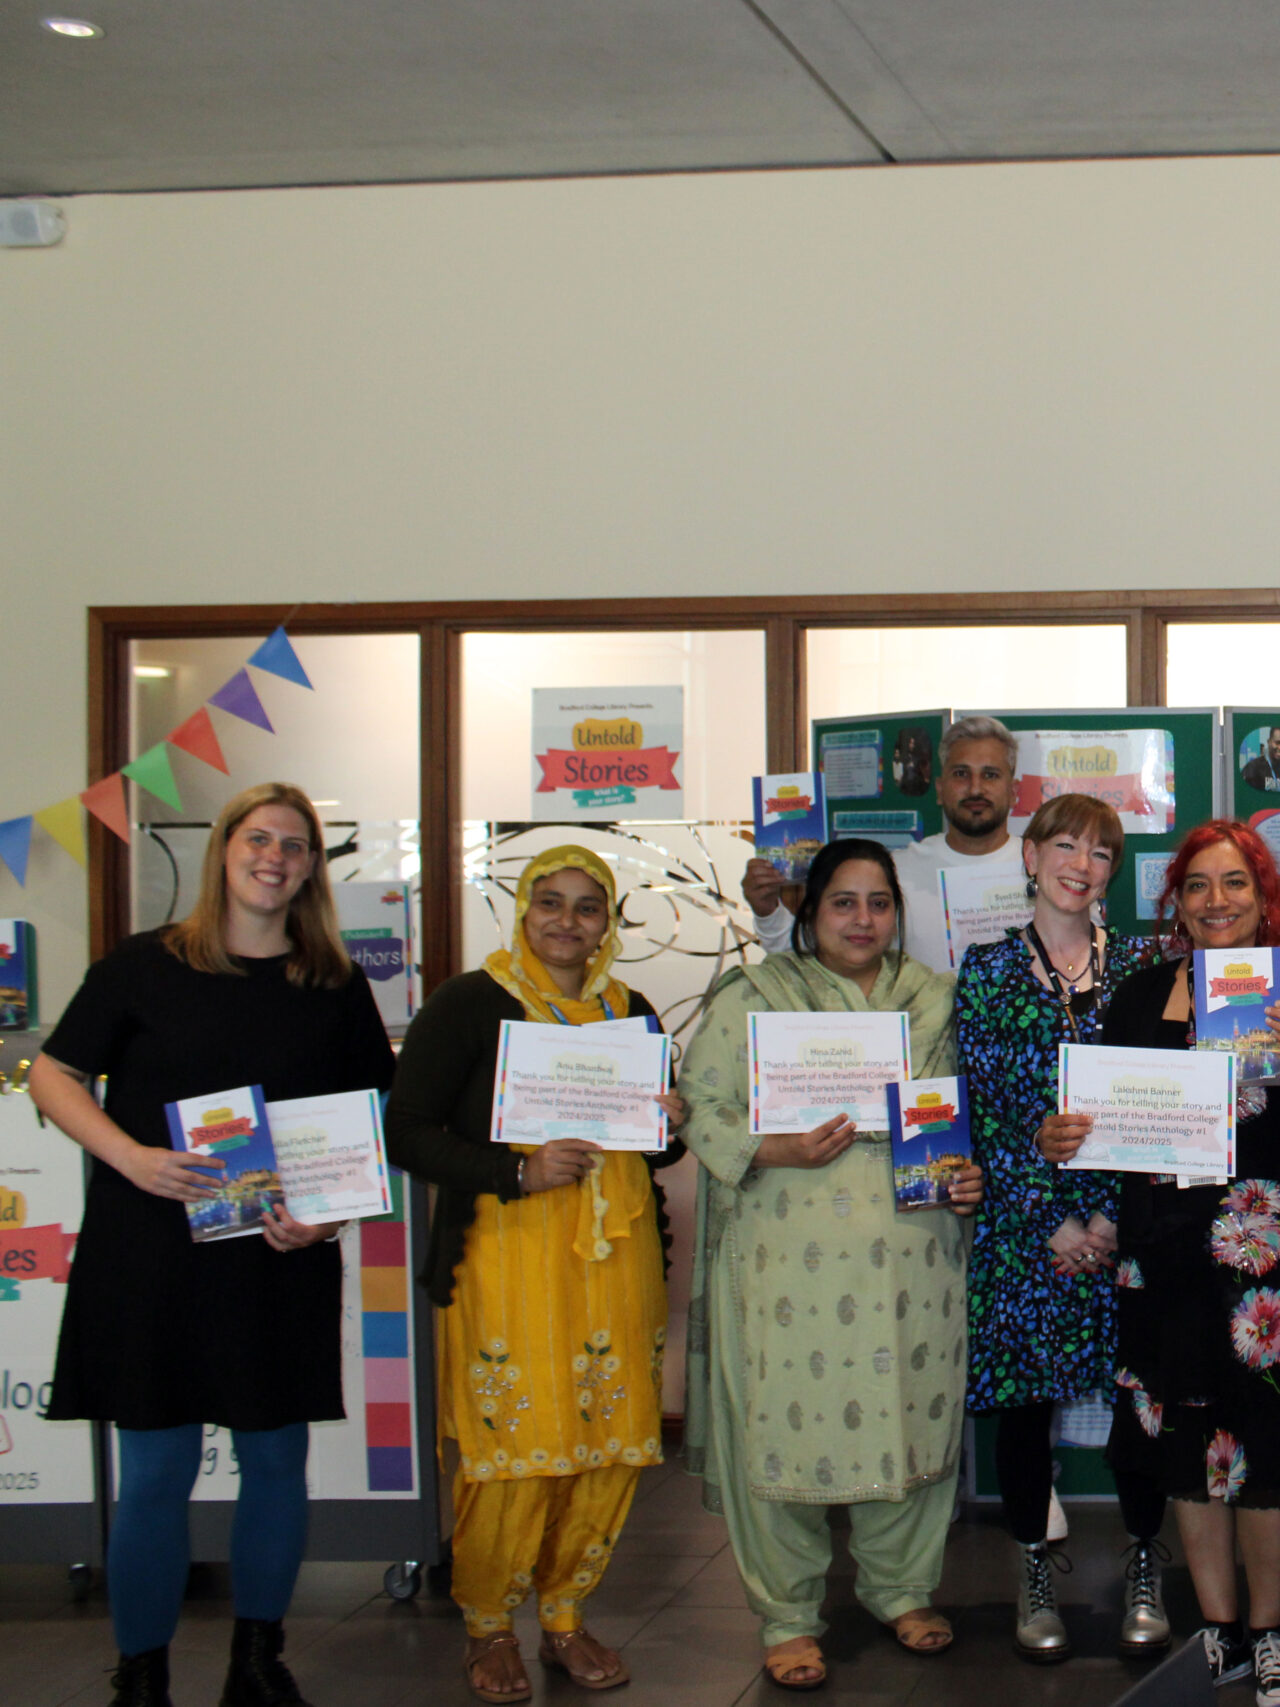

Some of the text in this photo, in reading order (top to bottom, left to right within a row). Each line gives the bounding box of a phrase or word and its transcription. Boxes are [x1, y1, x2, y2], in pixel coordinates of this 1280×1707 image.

[577, 725, 636, 746] Untold
[1053, 752, 1111, 772] Untold
[564, 756, 649, 783] Stories
[1040, 782, 1123, 807] Stries
[352, 947, 401, 966] thors
[1217, 980, 1261, 993] Stories
[764, 1061, 789, 1069] Thank
[806, 1060, 816, 1068] for
[818, 1060, 842, 1069] telling
[863, 1061, 882, 1069] story
[766, 1073, 788, 1082] being
[790, 1074, 806, 1082] part
[818, 1072, 830, 1080] the
[833, 1072, 867, 1080] Bradford
[868, 1071, 896, 1081] College
[640, 1081, 655, 1089] and
[778, 1084, 875, 1094] Untold Stories Anthology
[1113, 1085, 1181, 1096] Lakshmi Banner
[810, 1096, 856, 1104] 2024/2025
[1073, 1096, 1222, 1111] Thank you for telling your story and
[910, 1109, 949, 1121] Stories
[1100, 1112, 1118, 1120] part
[1132, 1112, 1146, 1120] the
[1147, 1113, 1184, 1122] Bradford
[1187, 1114, 1219, 1125] College
[196, 1122, 244, 1141] Stories
[1118, 1124, 1148, 1133] Stories
[1150, 1126, 1194, 1136] Anthology
[1122, 1137, 1172, 1145] 2024/2025
[0, 1196, 18, 1221] d
[3, 1248, 37, 1272] es
[0, 1472, 40, 1490] 025
